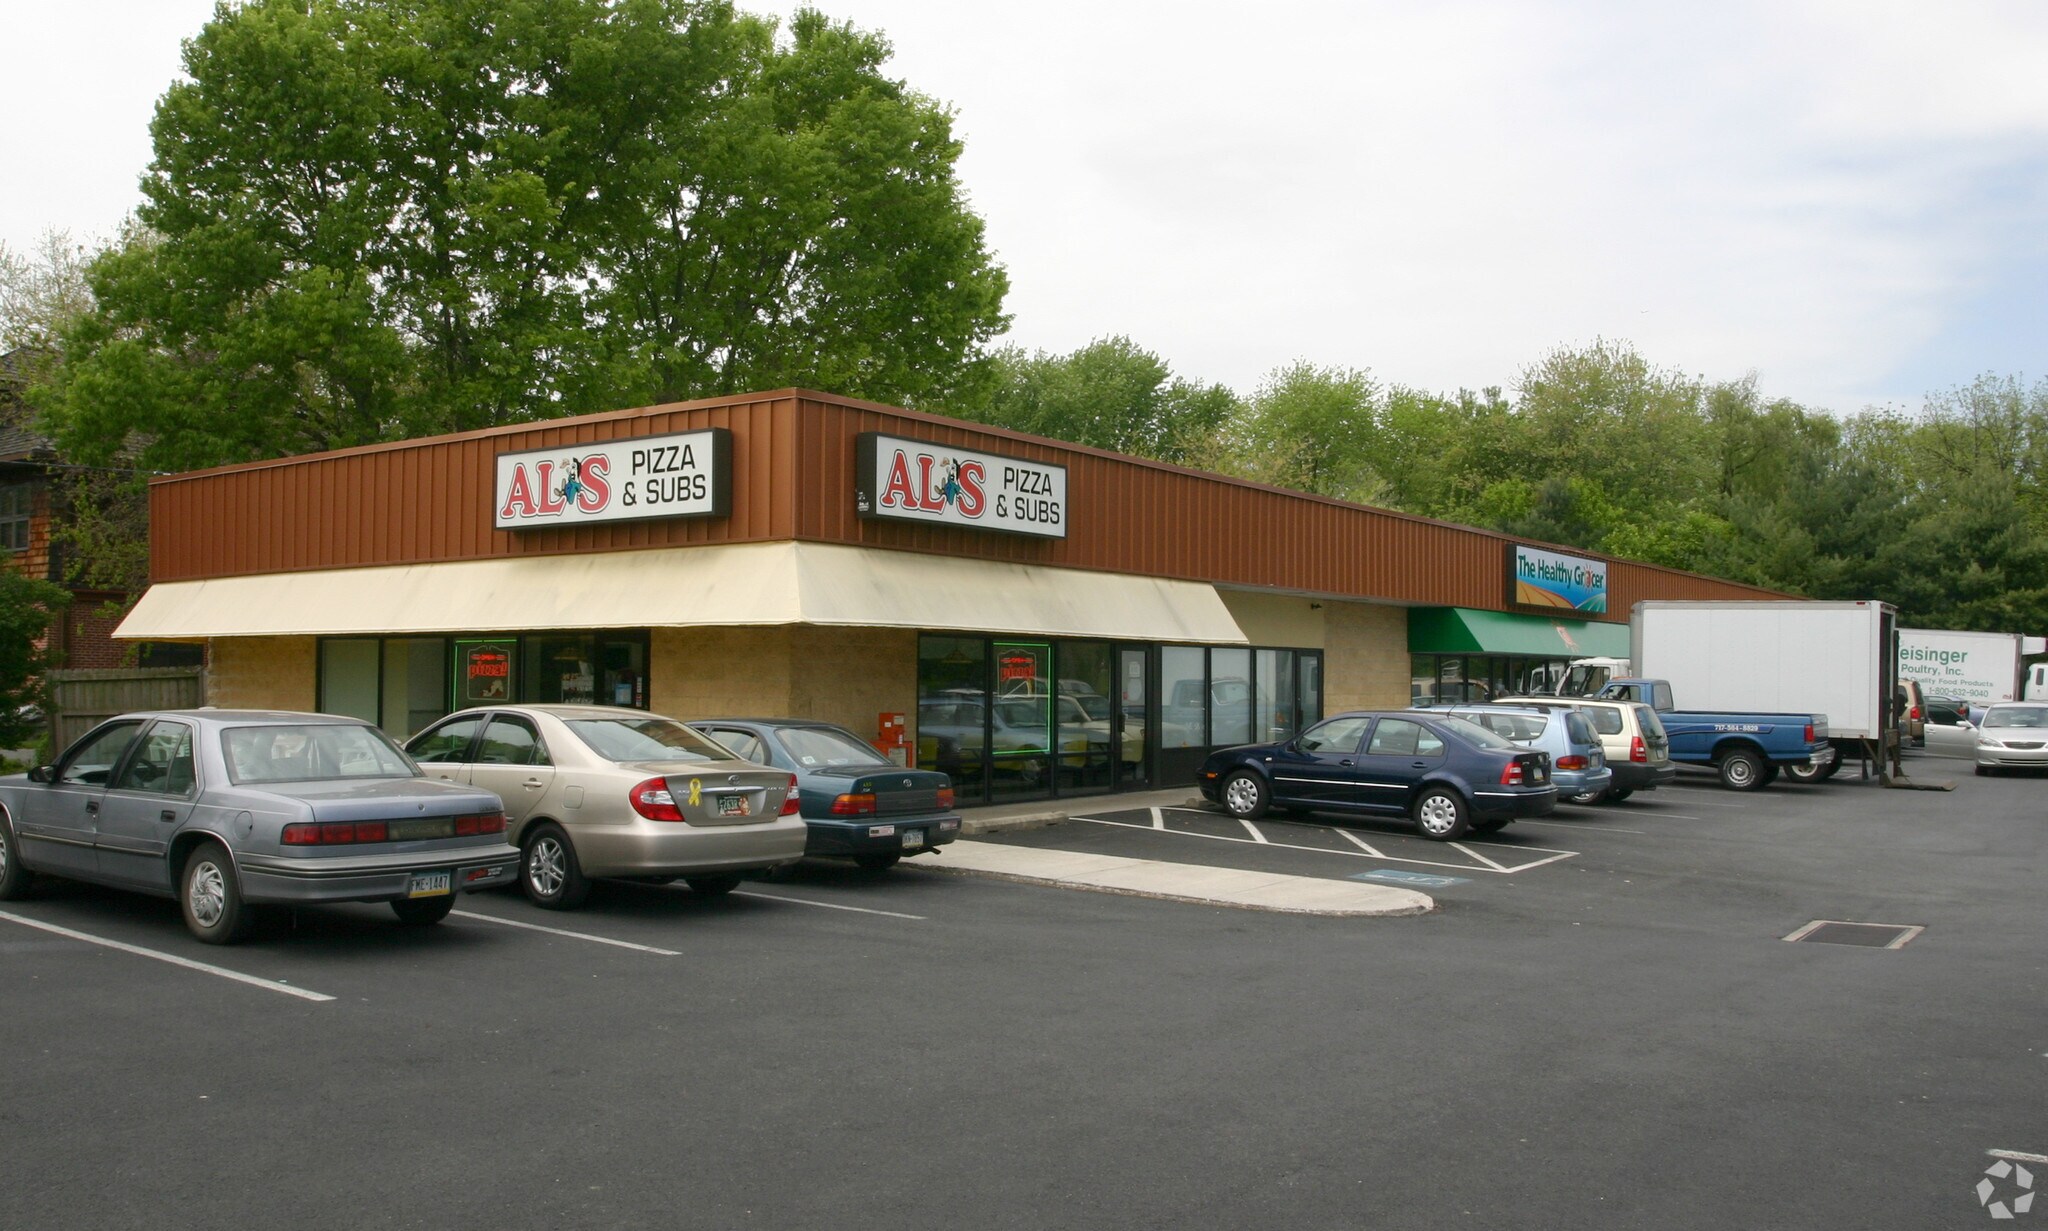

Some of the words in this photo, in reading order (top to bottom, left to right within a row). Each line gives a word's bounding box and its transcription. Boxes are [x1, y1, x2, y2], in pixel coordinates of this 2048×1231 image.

[632, 444, 696, 476] PIZZA
[622, 481, 637, 507] &
[645, 474, 707, 505] SUBS
[1004, 467, 1052, 496] PIZZA
[995, 494, 1009, 518] &
[1014, 497, 1061, 525] SUBS
[1518, 554, 1536, 578] The
[1537, 559, 1573, 589] Healthy
[1900, 646, 1968, 665] eisinger
[1901, 664, 1940, 675] Poultry,
[1945, 666, 1965, 676] Inc.
[1938, 678, 1958, 686] Food
[1960, 679, 1994, 688] Products
